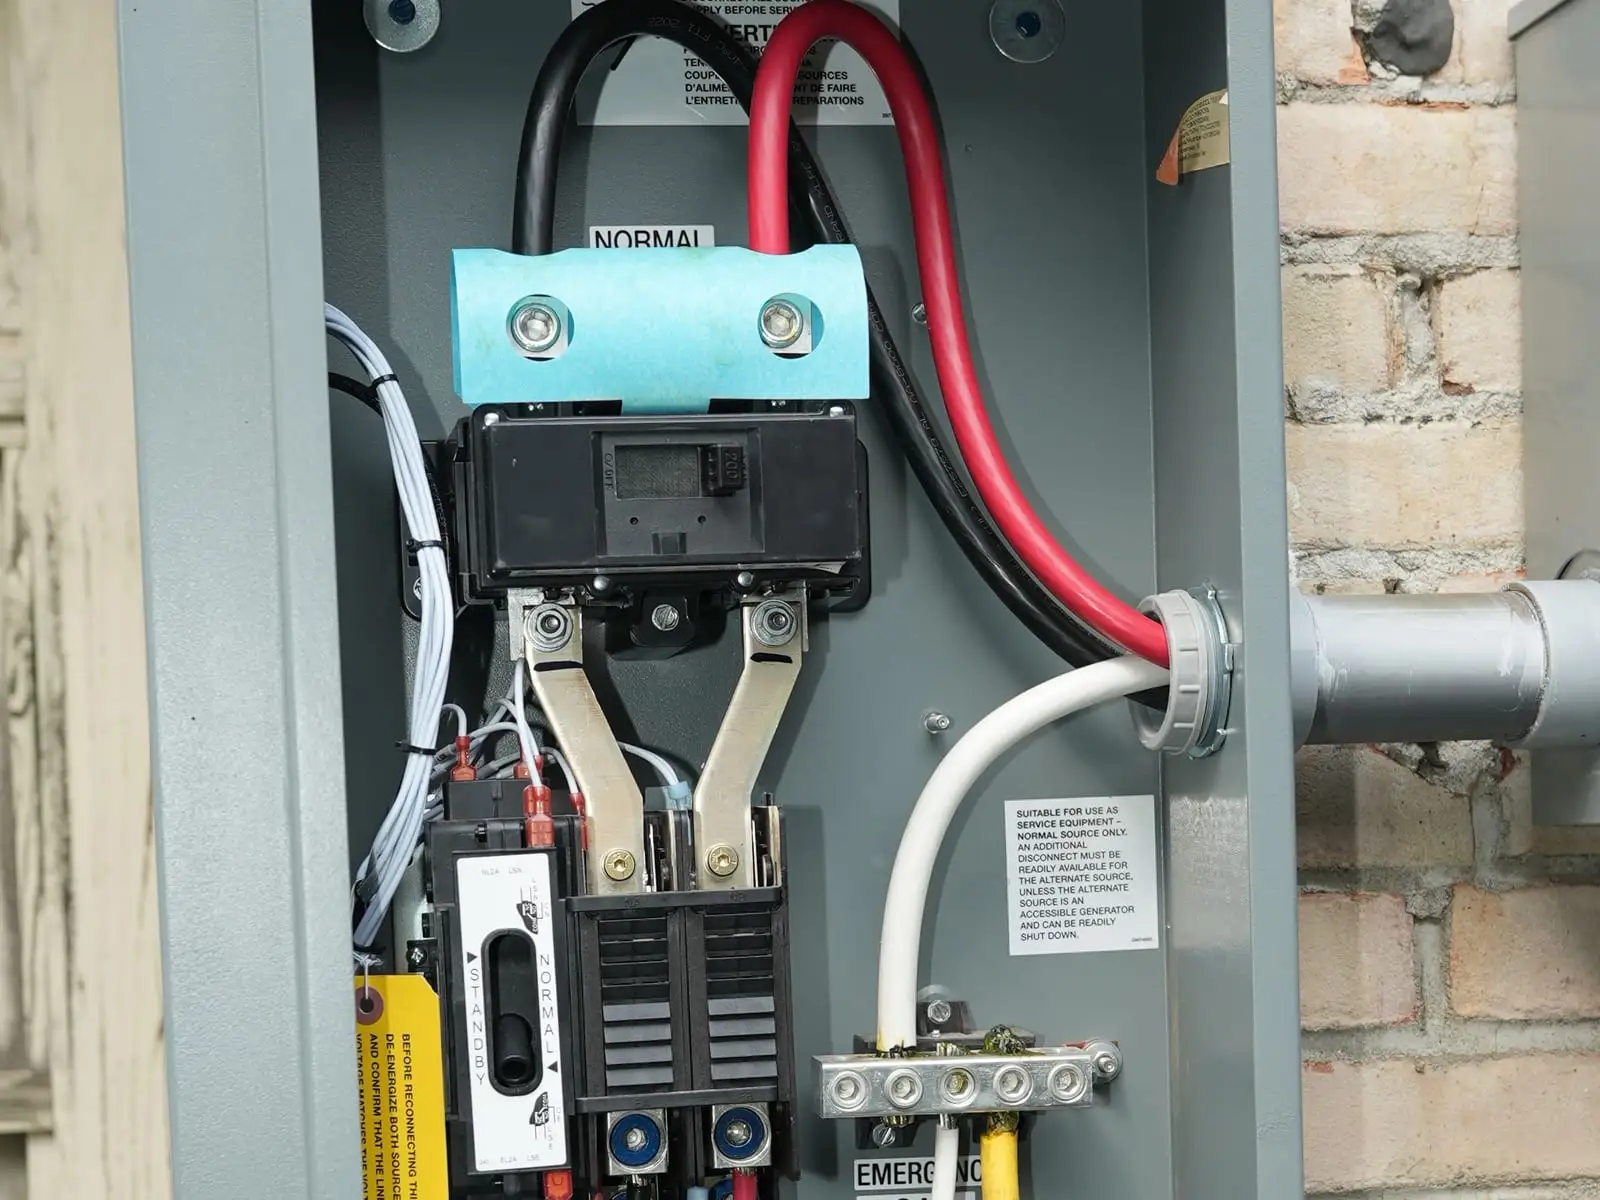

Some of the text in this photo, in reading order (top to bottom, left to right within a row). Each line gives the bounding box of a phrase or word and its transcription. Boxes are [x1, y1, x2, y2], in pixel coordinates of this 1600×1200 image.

[725, 6, 766, 15] BEFORE
[769, 6, 795, 14] SERV
[684, 71, 717, 80] COUP
[685, 83, 729, 92] D'ALIME
[811, 84, 824, 93] DE
[827, 83, 857, 93] FAIRE
[594, 229, 699, 248] NORMAL
[1016, 806, 1119, 818] SUITABLE FOR USE AS
[1017, 820, 1056, 829] SERVICE
[1059, 818, 1114, 828] EQUIPMENT
[1017, 829, 1127, 840] NORMAL SOURCE ONLY.
[1018, 842, 1087, 851] AN ADDITIONAL
[1018, 851, 1121, 862] DISCONNECT MUST BE
[1019, 862, 1128, 874] READILY AVAILABLE FOR
[1019, 876, 1037, 885] THE
[1039, 874, 1090, 884] ALTERNATE
[1019, 884, 1129, 896] UNLESS THE ALTERNATE
[1019, 898, 1058, 907] SOURCE
[1071, 897, 1084, 905] AN
[1020, 906, 1135, 918] ACCESSIBLE GENERATOR
[1020, 918, 1116, 930] AND CAN BE READILY
[1021, 931, 1079, 941] SHUT DOWN.
[540, 954, 555, 1054] NORMAL
[470, 968, 486, 1085] STANDBY
[370, 1033, 379, 1058] AND
[386, 1033, 398, 1113] DE-ENERGIZE
[371, 1062, 382, 1116] CONFIRM
[402, 1033, 418, 1200] BEFORE RECONNECTING THI
[374, 1120, 383, 1149] THAT
[389, 1116, 399, 1149] BOTH
[375, 1152, 384, 1175] THE
[857, 1160, 983, 1186] EMERGNC
